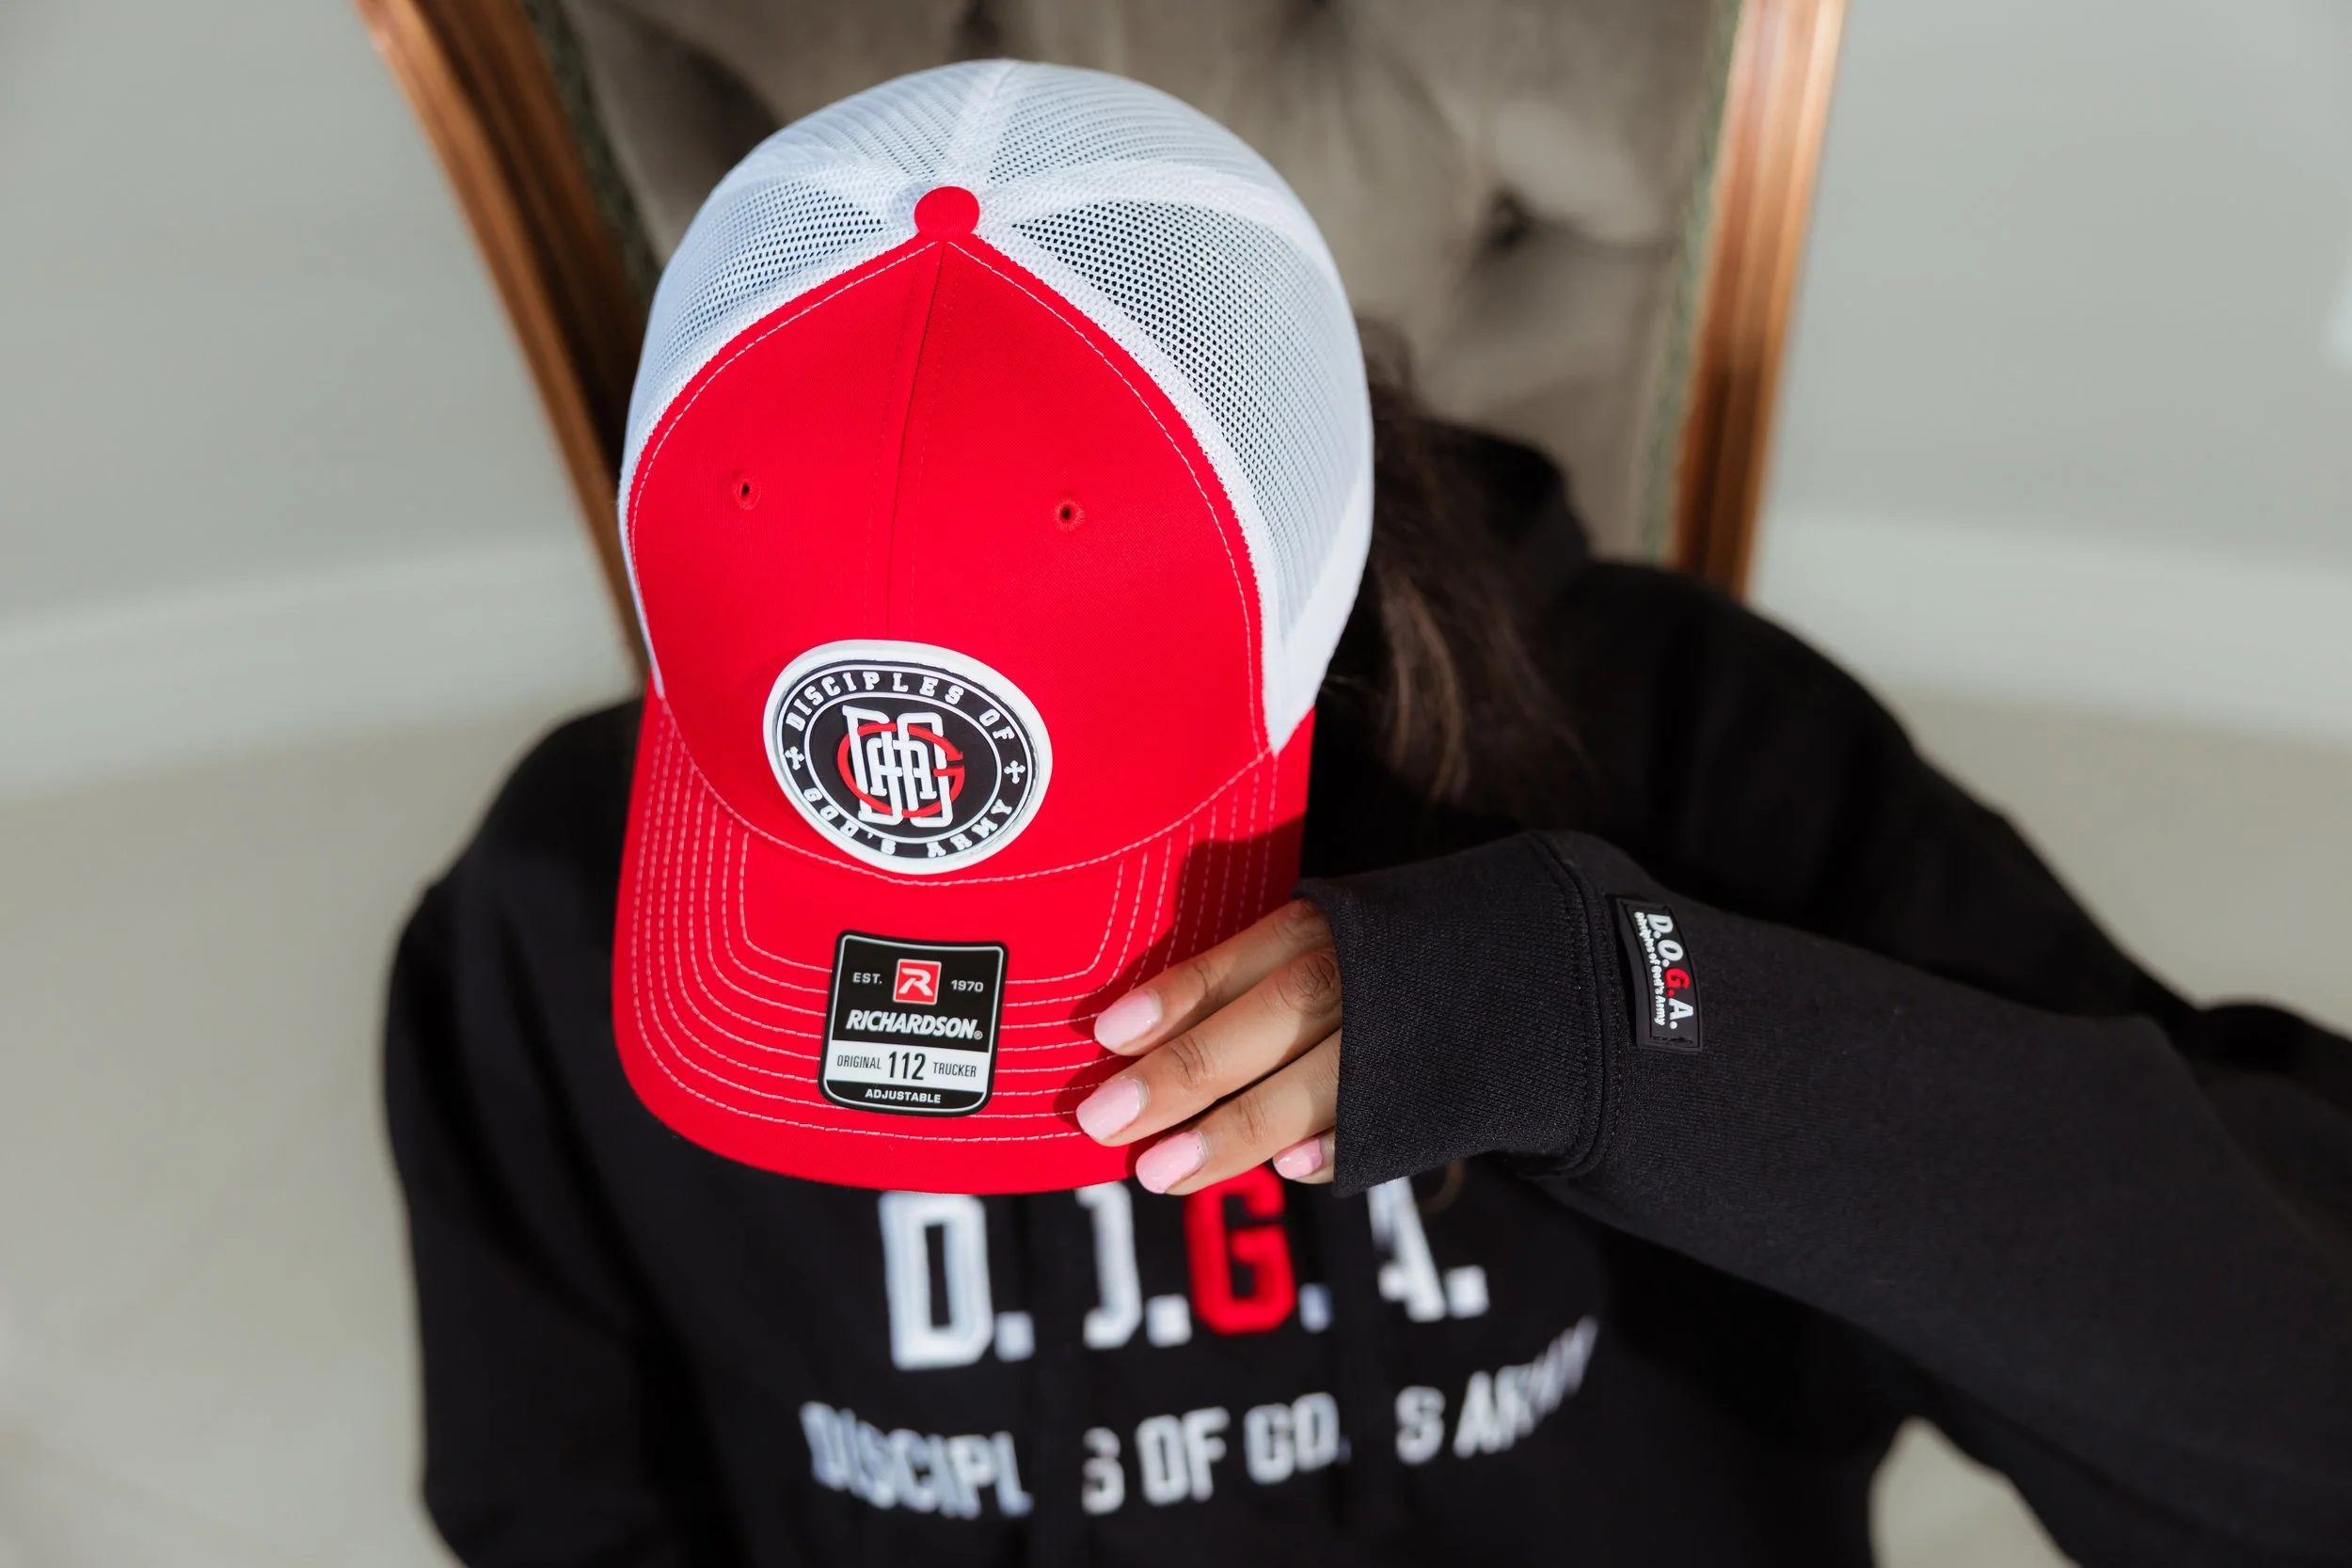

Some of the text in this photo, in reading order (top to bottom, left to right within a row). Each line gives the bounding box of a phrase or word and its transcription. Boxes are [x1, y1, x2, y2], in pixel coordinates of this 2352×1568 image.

[786, 671, 1015, 741] DISCIPLES OF
[803, 787, 1013, 858] GOD'S ARMY
[852, 973, 984, 992] EST. 1970
[1646, 913, 1694, 1030] D.O.G.A.
[1654, 995, 1666, 1026] Army
[836, 1051, 977, 1081] ORIGINAL 112 TRUCKER
[865, 1088, 942, 1103] ADJUSTABLE
[801, 1401, 1125, 1521] DISCIPLS
[1136, 1407, 1230, 1505] OF
